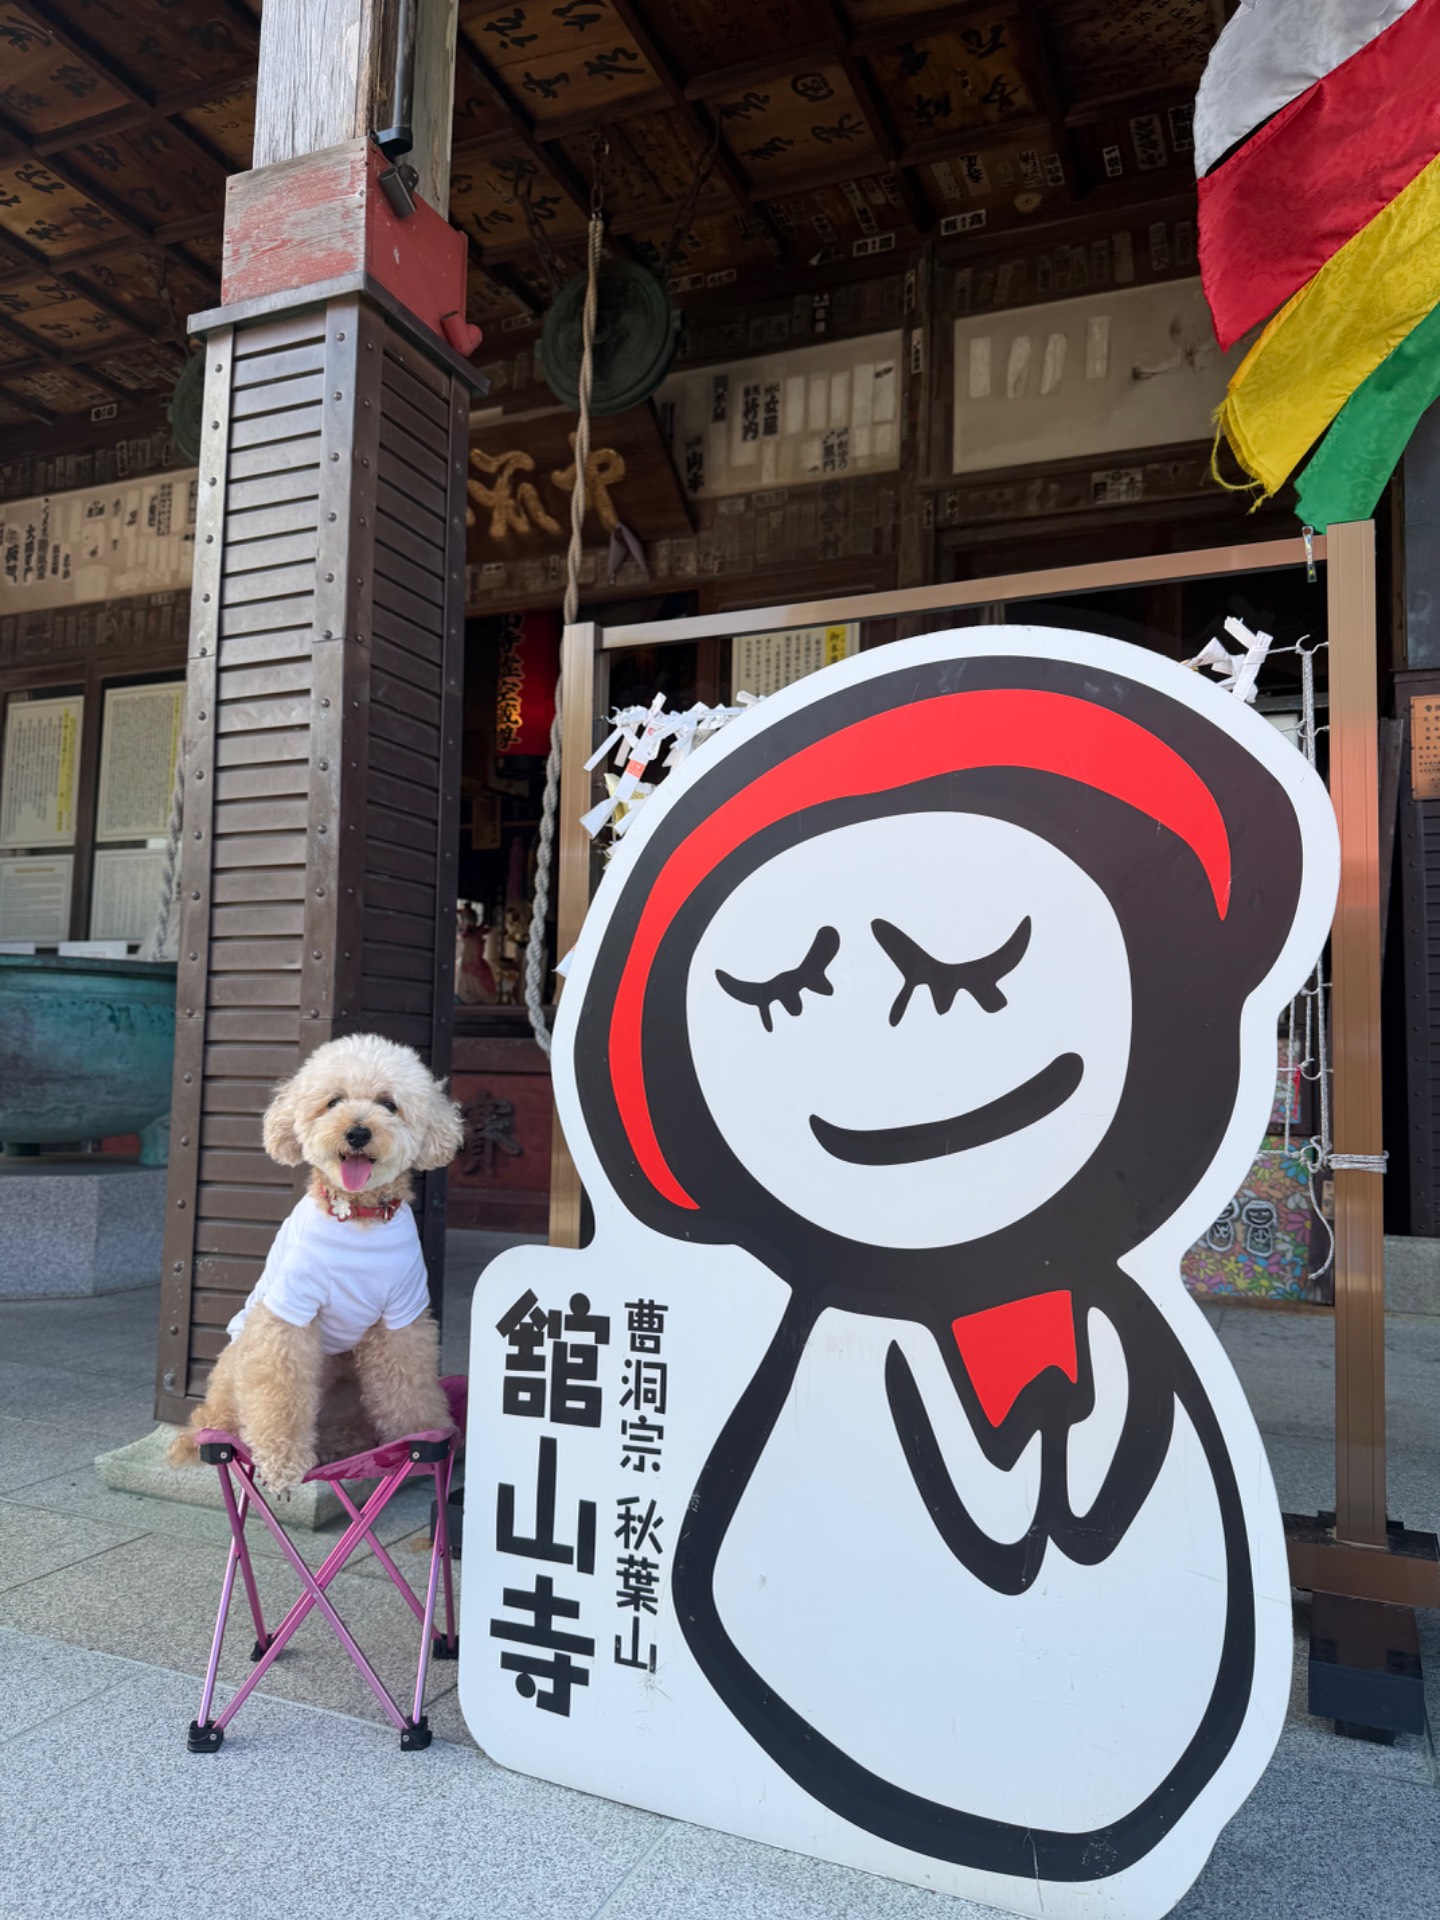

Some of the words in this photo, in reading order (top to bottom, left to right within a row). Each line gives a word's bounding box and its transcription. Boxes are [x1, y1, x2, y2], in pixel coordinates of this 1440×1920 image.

[619, 1298, 669, 1473] 曹洞宗
[614, 1496, 664, 1674] 秋葉山
